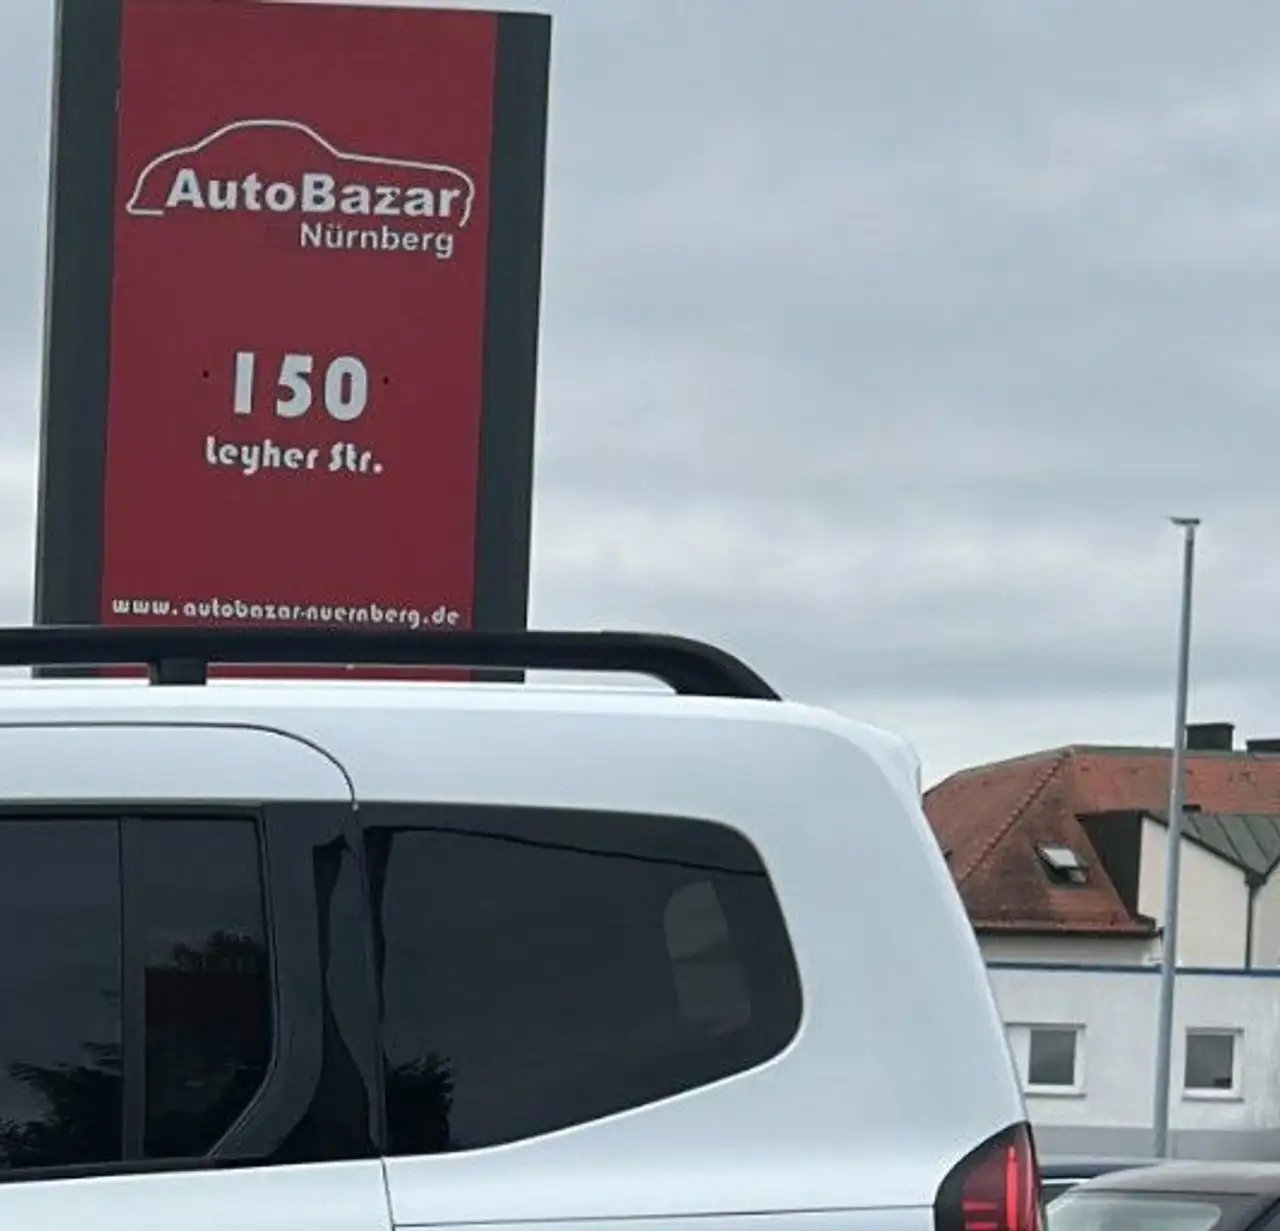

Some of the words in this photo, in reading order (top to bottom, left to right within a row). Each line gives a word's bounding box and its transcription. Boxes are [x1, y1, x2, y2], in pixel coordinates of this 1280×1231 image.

[165, 168, 461, 217] AutoBazar
[300, 221, 454, 259] Nürnberg
[234, 351, 368, 421] 150
[206, 435, 319, 476] Leyher
[328, 441, 383, 473] Str.
[112, 597, 460, 630] www.autobazar-nuernberg.de
